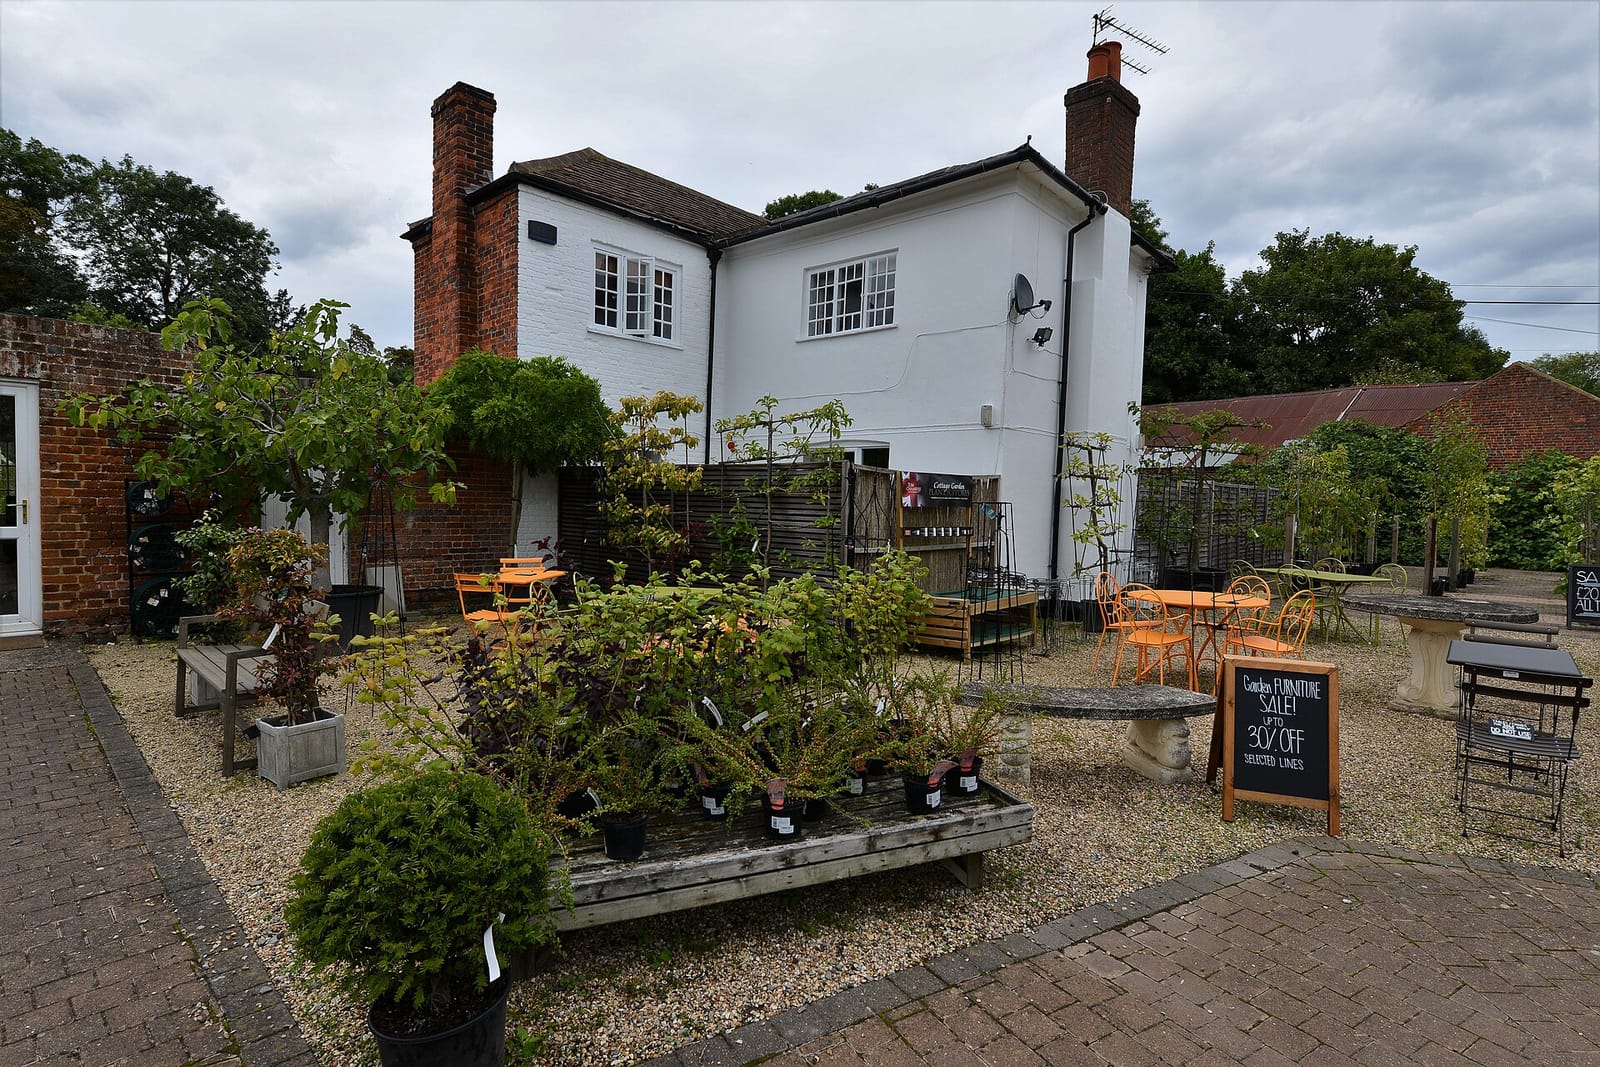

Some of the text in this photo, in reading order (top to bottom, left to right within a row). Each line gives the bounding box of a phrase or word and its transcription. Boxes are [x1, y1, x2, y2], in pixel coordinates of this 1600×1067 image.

[934, 481, 950, 492] Cottage
[1575, 599, 1594, 612] ALL
[1244, 674, 1321, 700] Garden FURNITURE
[1259, 694, 1296, 715] SALE!
[1248, 725, 1305, 754] 30% OFF
[1244, 753, 1304, 771] SELECTED LINES
